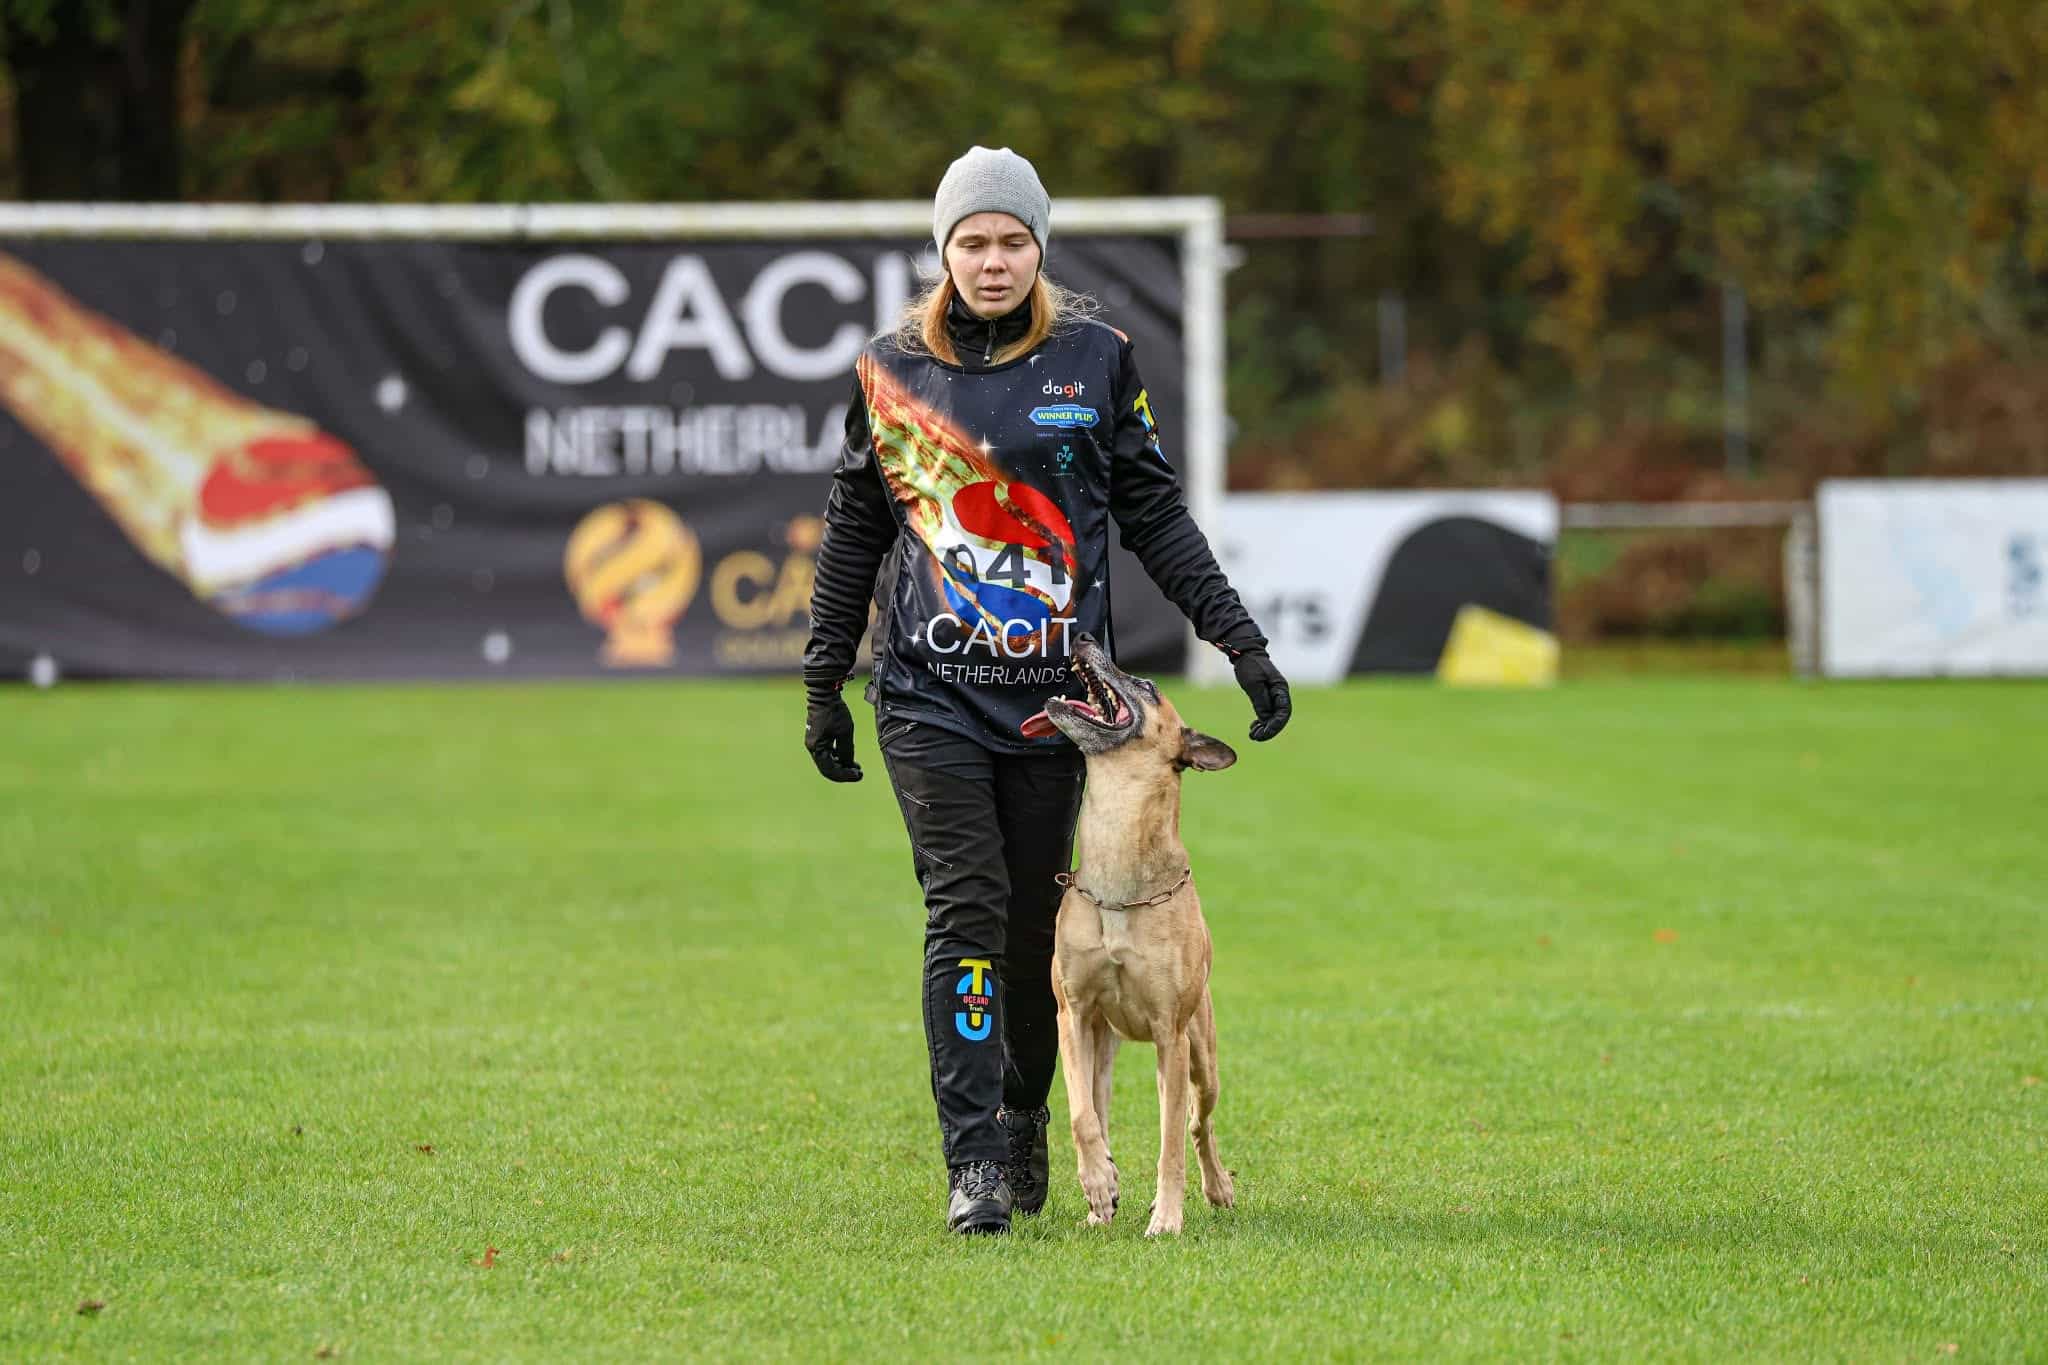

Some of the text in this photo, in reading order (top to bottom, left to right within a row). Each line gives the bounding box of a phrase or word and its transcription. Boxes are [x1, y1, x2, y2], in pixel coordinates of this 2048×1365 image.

[1042, 379, 1085, 398] dogit
[1037, 411, 1094, 423] WINNER PLUS
[926, 612, 1078, 660] CACIT
[927, 661, 1067, 686] NETHERLANDS
